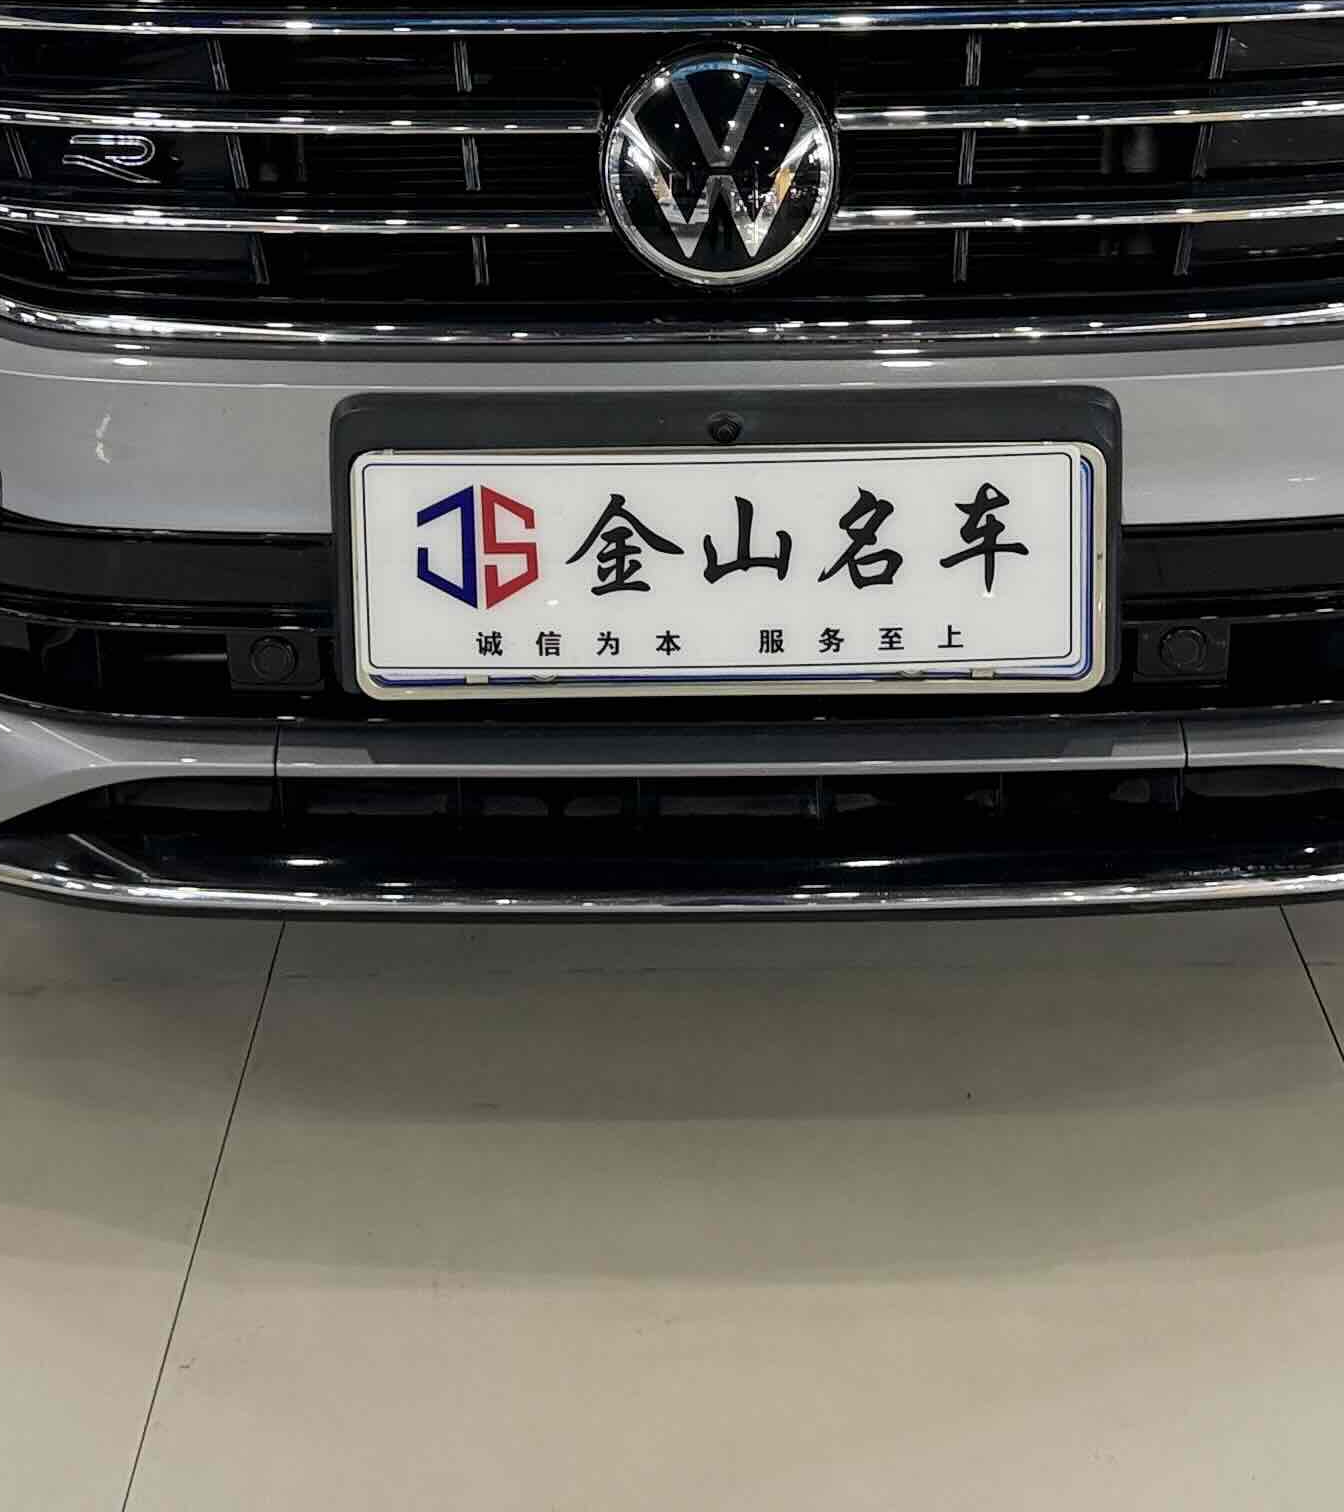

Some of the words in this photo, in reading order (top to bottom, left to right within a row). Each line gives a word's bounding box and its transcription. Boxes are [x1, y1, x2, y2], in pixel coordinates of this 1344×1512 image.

[565, 482, 1031, 598] 金山名车
[475, 628, 683, 658] 诚信为本
[758, 624, 965, 655] 服务至上
